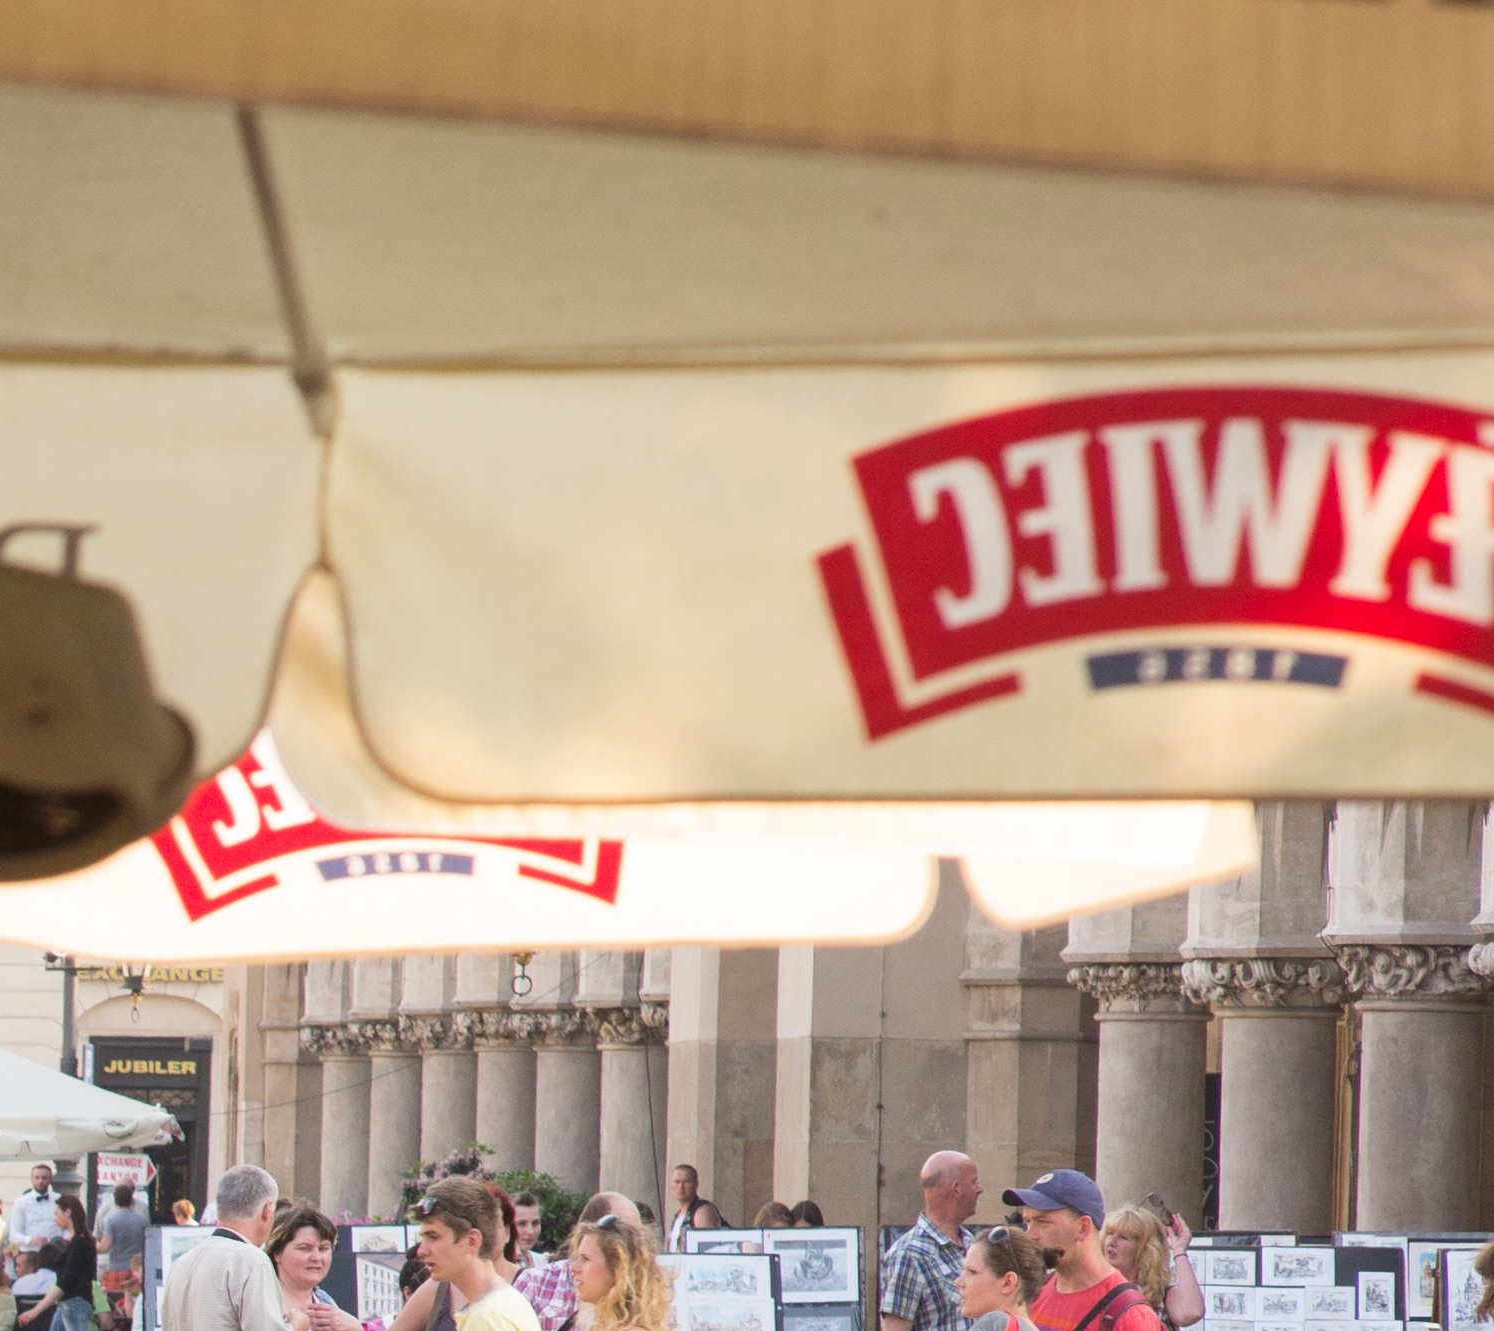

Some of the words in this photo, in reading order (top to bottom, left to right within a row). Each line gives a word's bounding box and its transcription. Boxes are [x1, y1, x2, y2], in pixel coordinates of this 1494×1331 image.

[77, 965, 224, 982] EXCANGE
[103, 1059, 197, 1075] JUBILER
[97, 1171, 138, 1182] ANTOR
